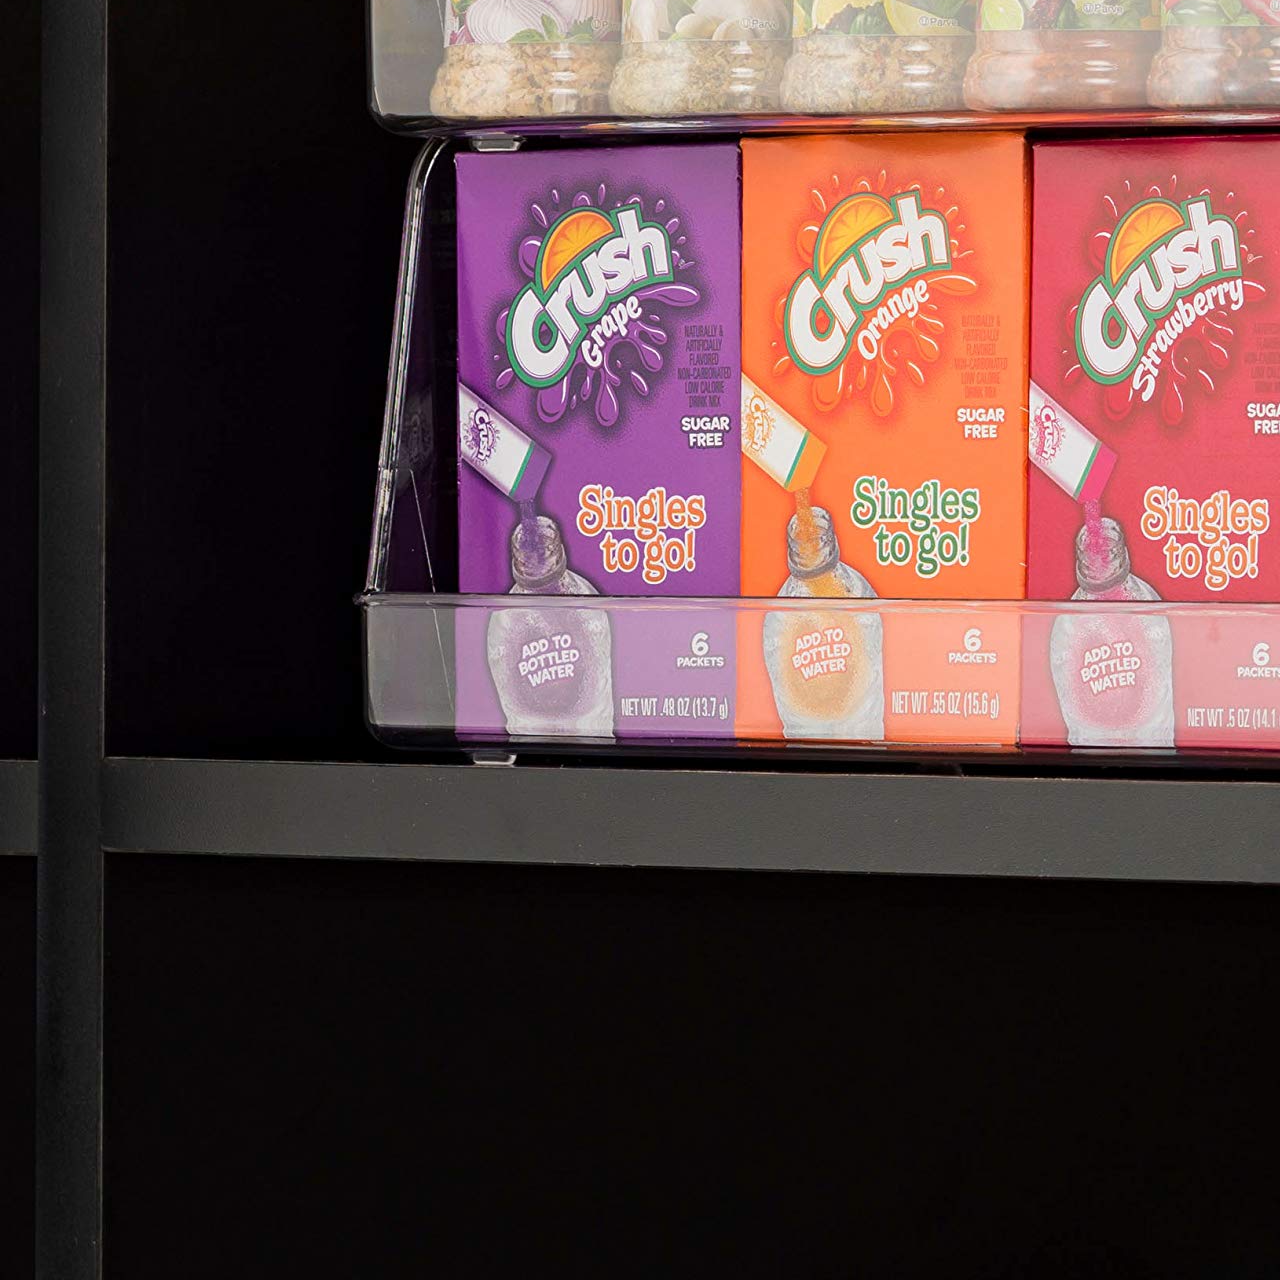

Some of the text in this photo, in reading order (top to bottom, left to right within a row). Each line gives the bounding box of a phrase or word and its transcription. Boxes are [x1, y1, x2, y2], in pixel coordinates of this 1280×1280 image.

[511, 208, 669, 380] Crush
[790, 195, 948, 369] Crush
[1082, 200, 1238, 377] Crush
[581, 295, 642, 367] Grape
[857, 279, 930, 360] Orange
[1132, 278, 1245, 402] Strawberry
[681, 416, 730, 431] SUGAR
[956, 407, 1006, 423] SUGAR
[689, 432, 724, 447] FREE
[964, 424, 998, 439] FREE
[576, 484, 706, 540] Singles
[850, 476, 980, 532] Singles
[1141, 485, 1270, 544] Singles
[600, 530, 696, 584] to go!
[874, 523, 970, 578] to go!
[1163, 534, 1260, 591] to go!
[521, 634, 572, 659] ADD TO
[691, 632, 709, 656] 6
[795, 628, 844, 652] ADD TO
[964, 628, 982, 652] 6
[518, 649, 580, 676] BOTTLED
[676, 656, 725, 668] PACKETS
[791, 643, 851, 669] BOTTLED
[948, 652, 997, 664] PACKETS
[1083, 642, 1134, 666] ADD TO
[1252, 642, 1270, 666] 6
[527, 663, 575, 688] WATER
[800, 658, 847, 681] WATER
[1080, 657, 1141, 683] BOTTLED
[1089, 671, 1136, 696] WATER
